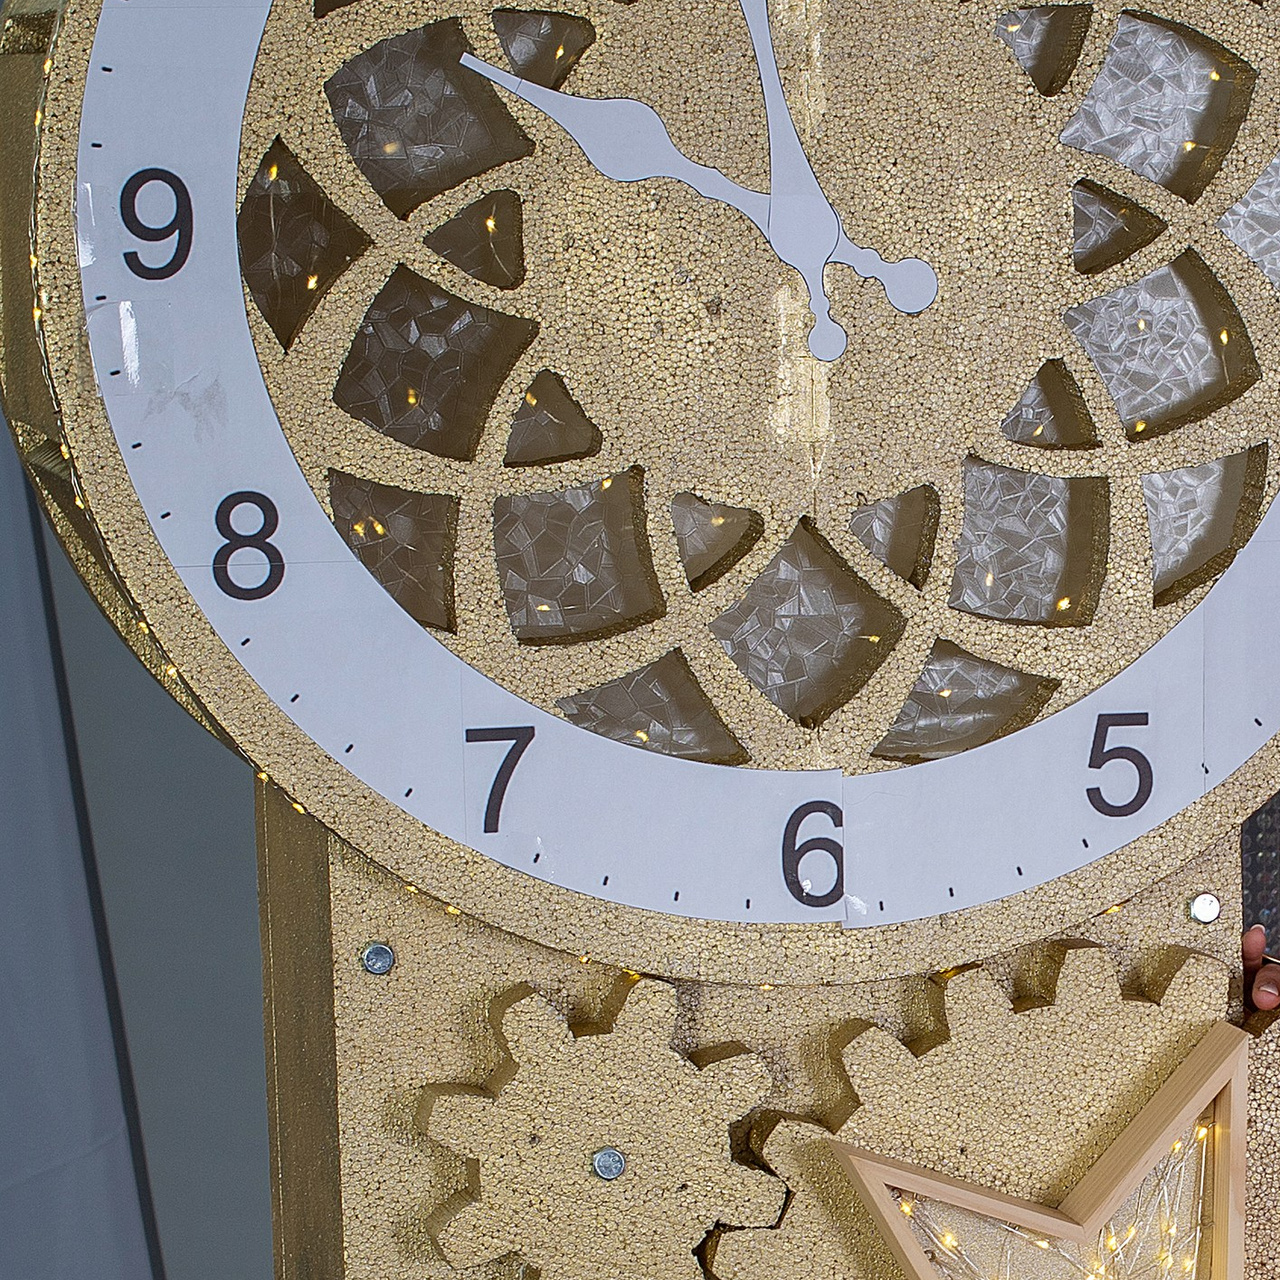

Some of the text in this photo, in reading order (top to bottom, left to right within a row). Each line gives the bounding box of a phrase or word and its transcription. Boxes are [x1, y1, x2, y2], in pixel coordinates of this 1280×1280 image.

[120, 168, 193, 280] 9
[213, 491, 285, 600] 8
[466, 726, 535, 833] 7
[1086, 712, 1153, 817] 5
[782, 801, 844, 907] 6
